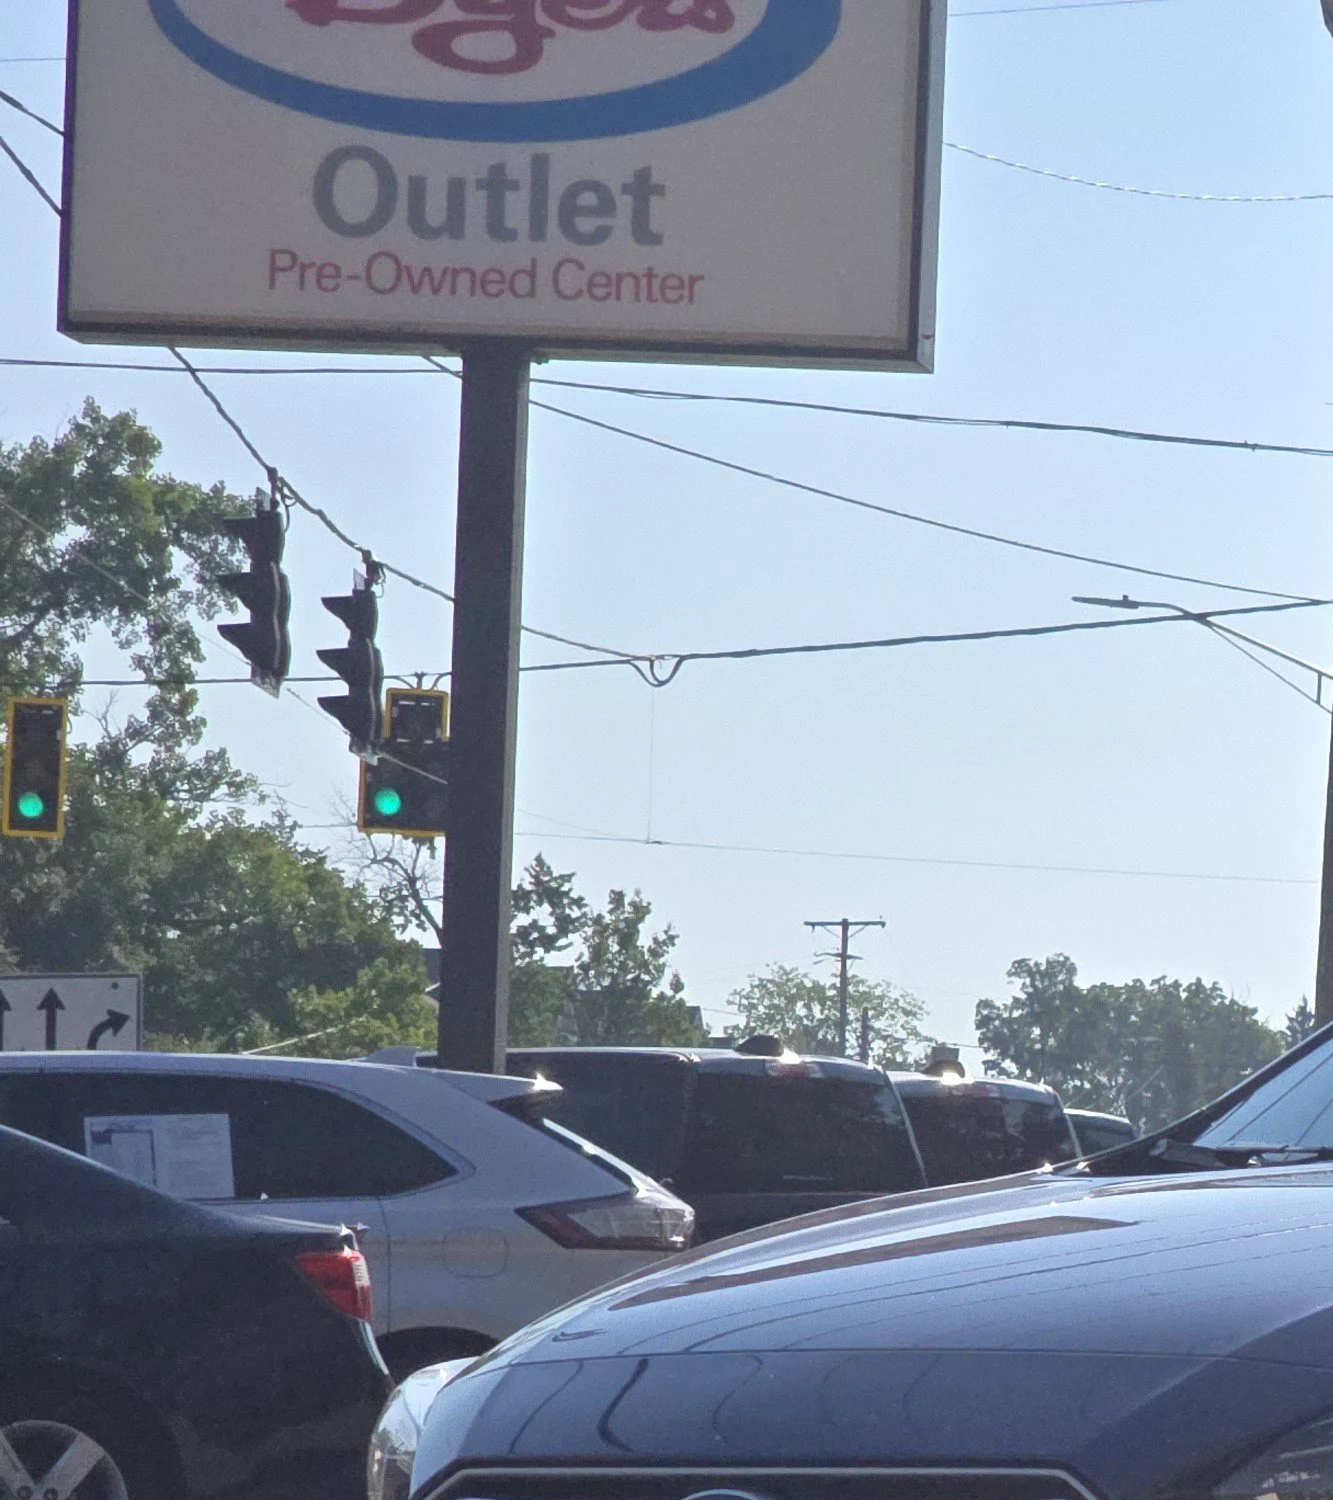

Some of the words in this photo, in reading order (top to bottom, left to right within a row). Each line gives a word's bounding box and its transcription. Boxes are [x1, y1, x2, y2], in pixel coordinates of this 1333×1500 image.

[313, 144, 666, 247] Outlet
[267, 248, 537, 300] Pre-Owned
[552, 257, 705, 305] Center
